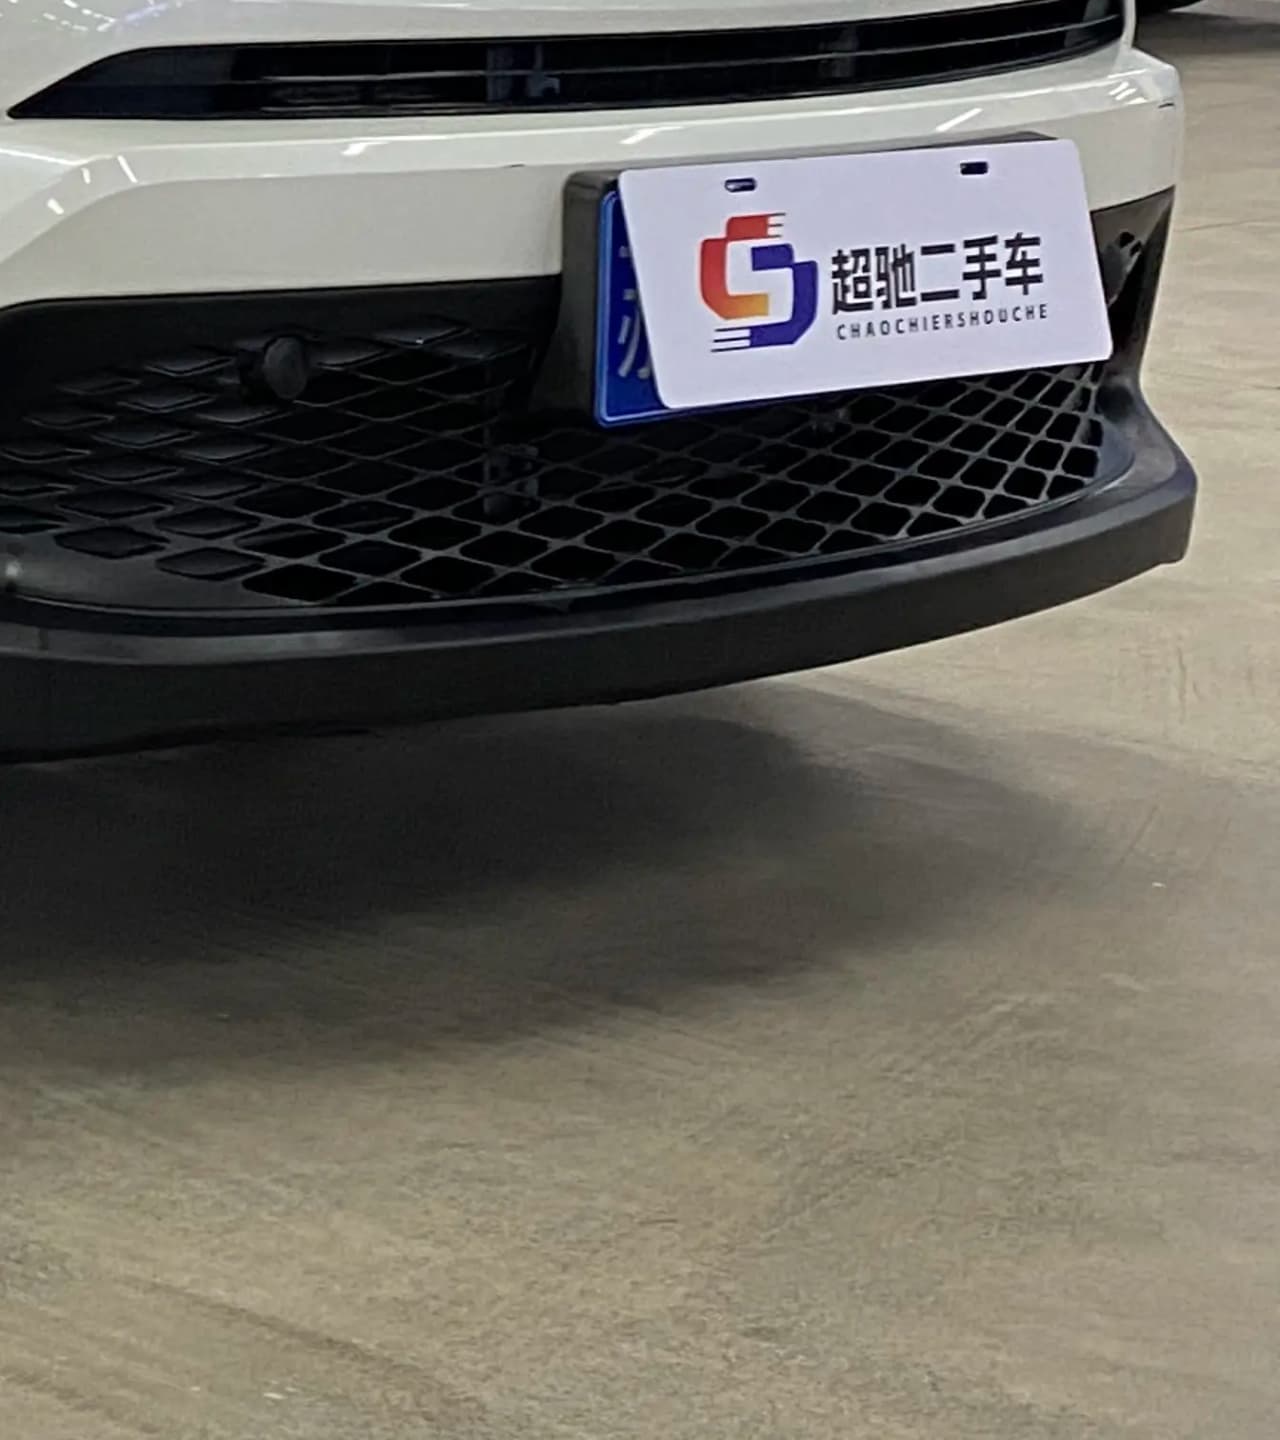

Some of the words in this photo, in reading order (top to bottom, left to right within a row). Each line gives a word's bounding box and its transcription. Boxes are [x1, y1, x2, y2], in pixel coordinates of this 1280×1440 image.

[831, 232, 1044, 315] 超驰二手车
[837, 303, 1048, 340] CHAOCHIERSHOUCHE
